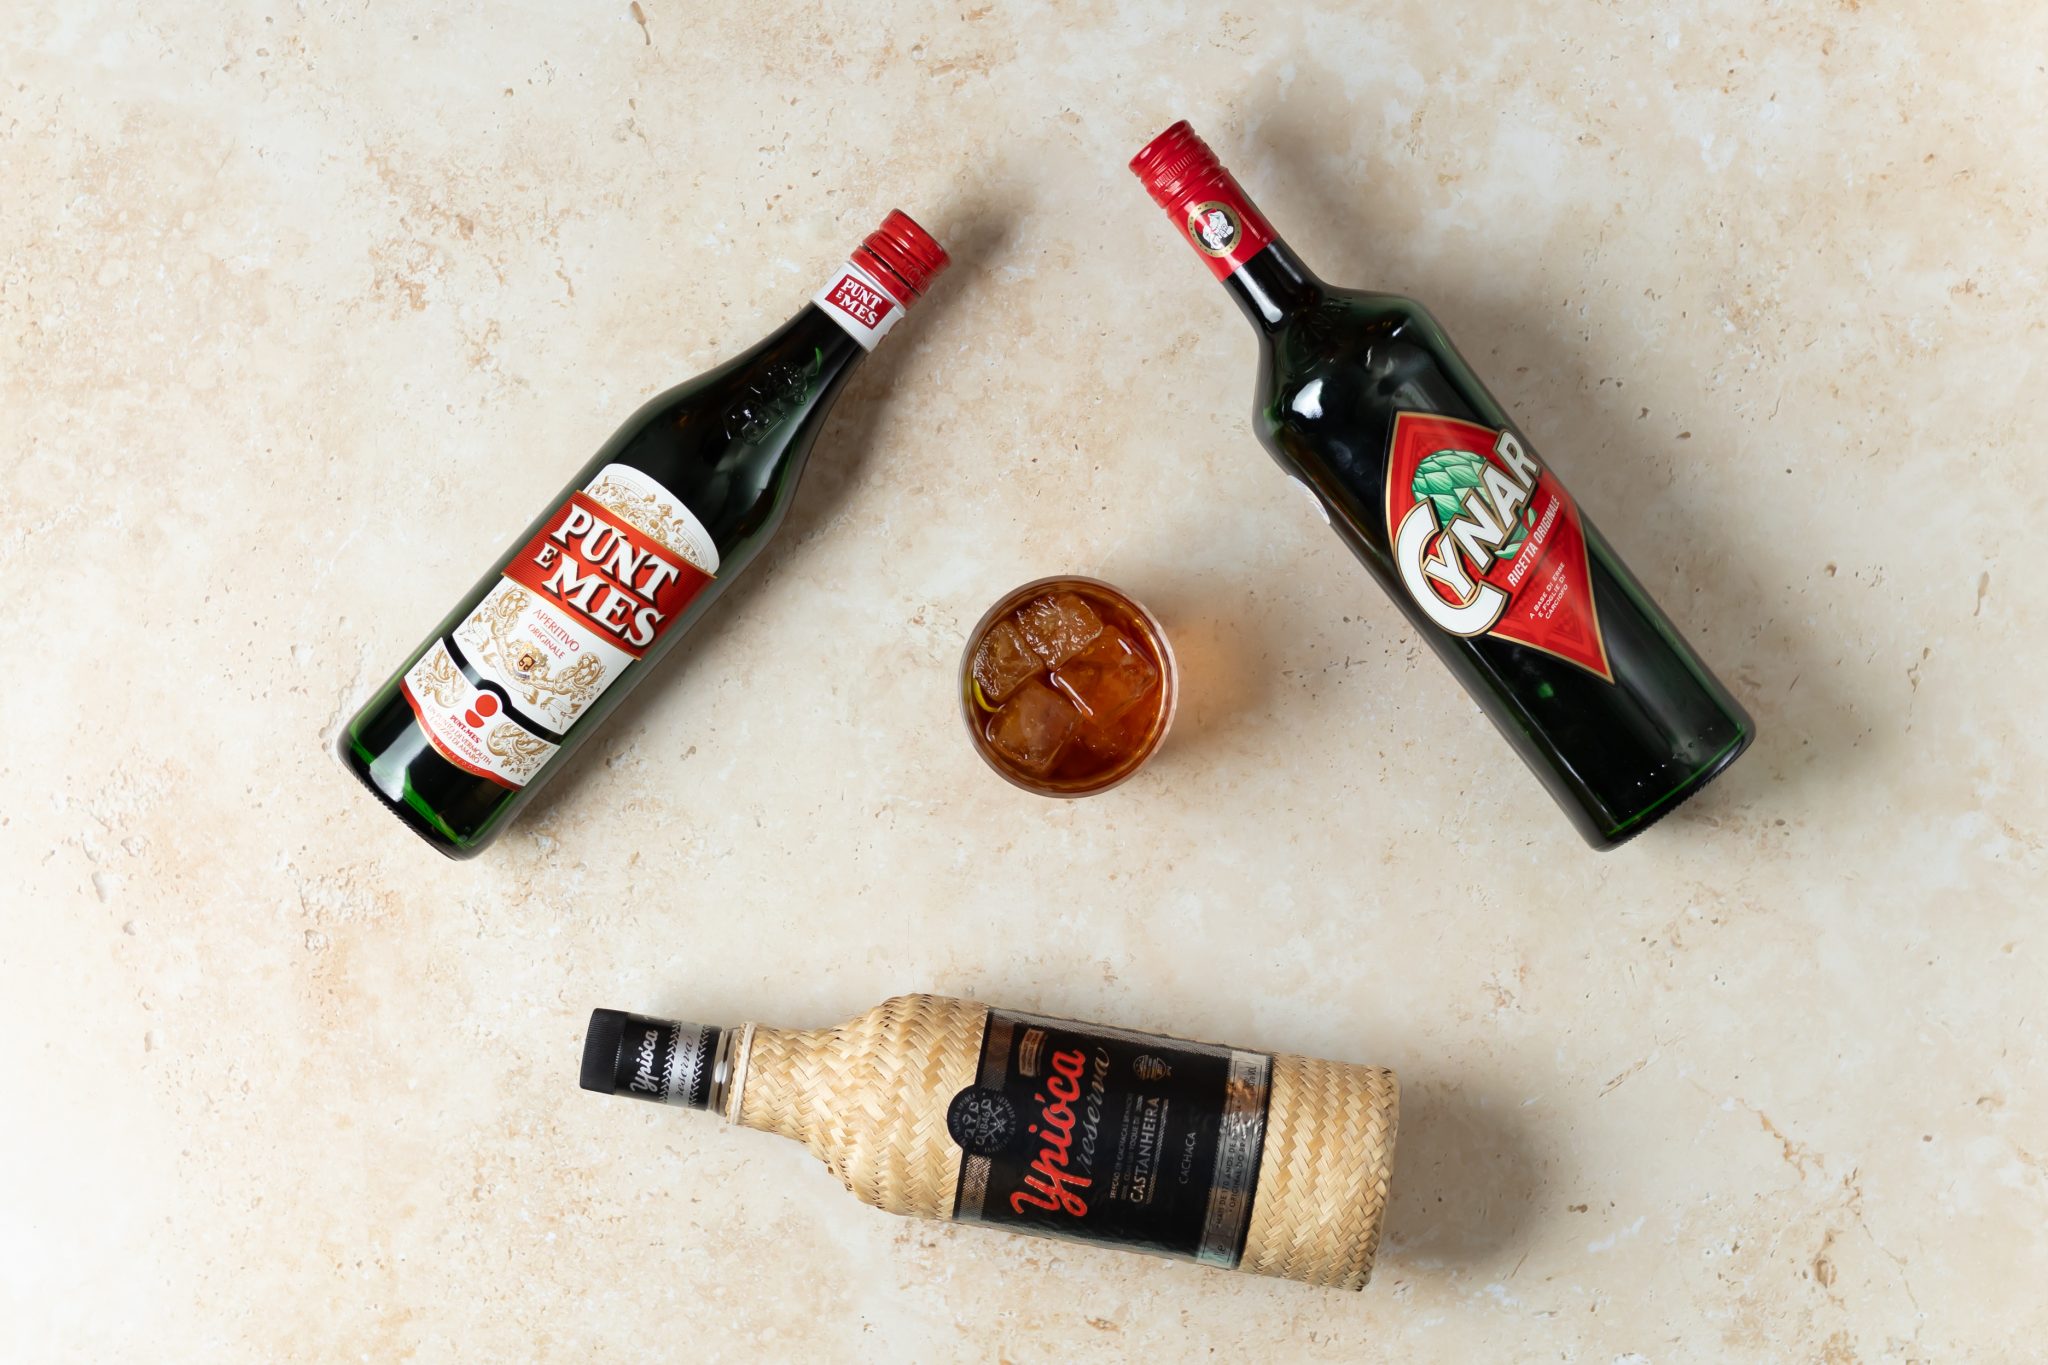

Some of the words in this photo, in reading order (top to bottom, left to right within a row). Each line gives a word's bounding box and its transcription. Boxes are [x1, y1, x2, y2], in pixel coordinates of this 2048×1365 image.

[839, 295, 878, 325] MES
[841, 278, 882, 310] PUNT
[1396, 430, 1540, 636] CYNAR
[1507, 542, 1537, 588] RICETTA
[1535, 494, 1561, 546] ORIGINALE
[534, 542, 559, 568] E
[550, 503, 679, 602] PUNT
[541, 555, 666, 647] MES
[1533, 592, 1548, 612] BASE
[1542, 583, 1561, 611] FOGLIE
[528, 624, 565, 659] ORIGINALE
[533, 609, 579, 651] APERITIVO
[458, 744, 480, 764] AMARO
[461, 737, 492, 765] VERMOUTH
[1130, 1097, 1160, 1203] CASTANHEIRA
[1179, 1132, 1196, 1185] CACHAÇA
